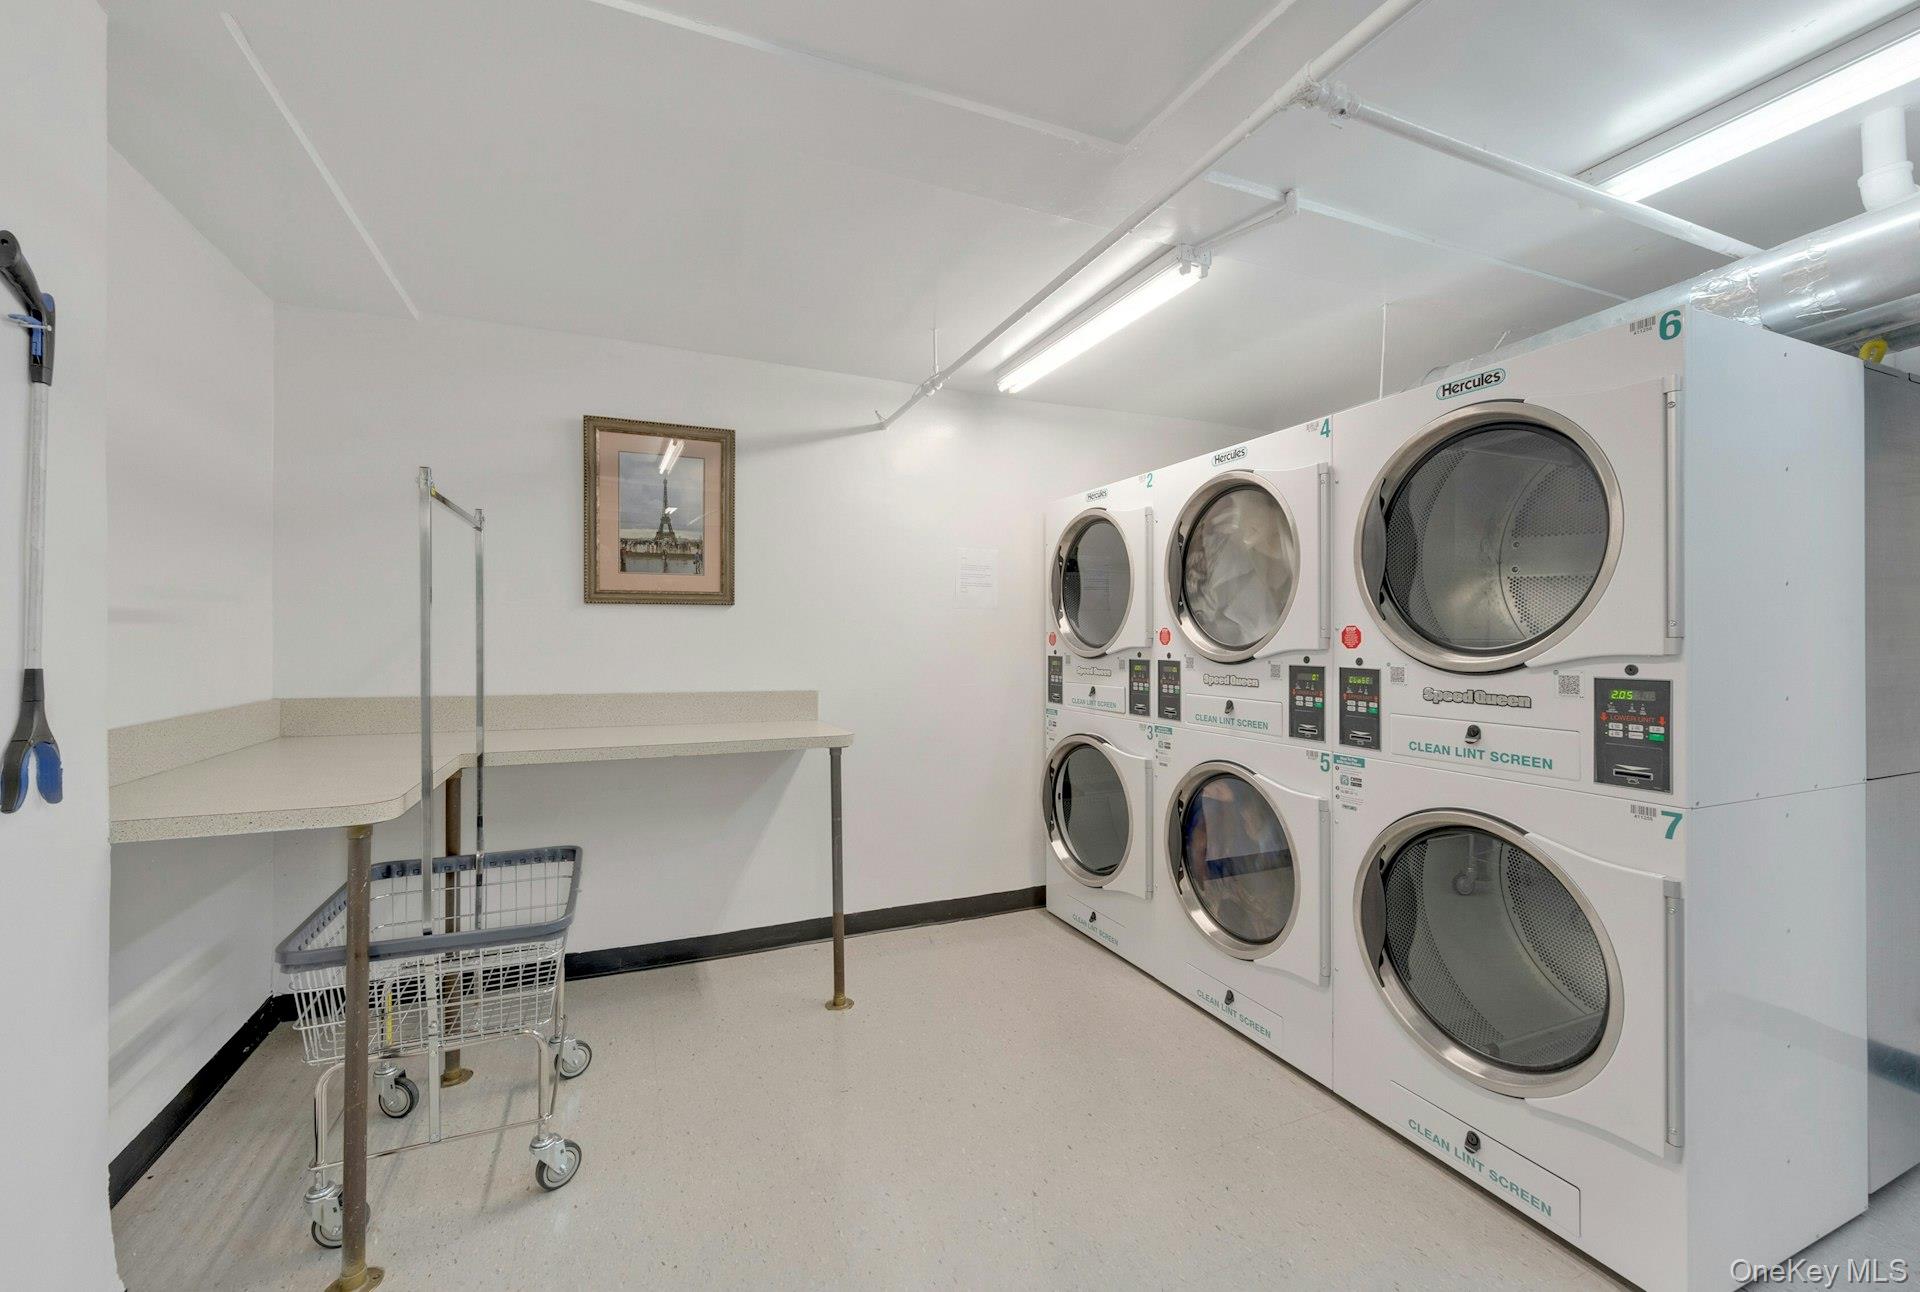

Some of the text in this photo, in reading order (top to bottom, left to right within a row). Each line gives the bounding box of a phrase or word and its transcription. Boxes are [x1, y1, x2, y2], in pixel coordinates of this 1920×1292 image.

[1659, 310, 1682, 340] 6
[1442, 371, 1501, 397] Hercules
[1320, 418, 1331, 438] 4
[1214, 448, 1246, 464] Hercules
[1146, 473, 1153, 488] 2
[1203, 673, 1259, 688] Speed Queen
[1097, 700, 1117, 709] SCREEN
[1422, 687, 1532, 708] Speed Queen
[1195, 714, 1269, 730] CLEAN LINT SCREEN
[1147, 725, 1153, 740] 3
[1320, 752, 1330, 772] 5
[1408, 741, 1553, 770] CLEAN LINT SCREEN
[1661, 810, 1683, 840] 7
[1196, 989, 1271, 1039] CLEAN LINT SCREEN
[1408, 1118, 1552, 1217] CLEAN LINT SCREEN
